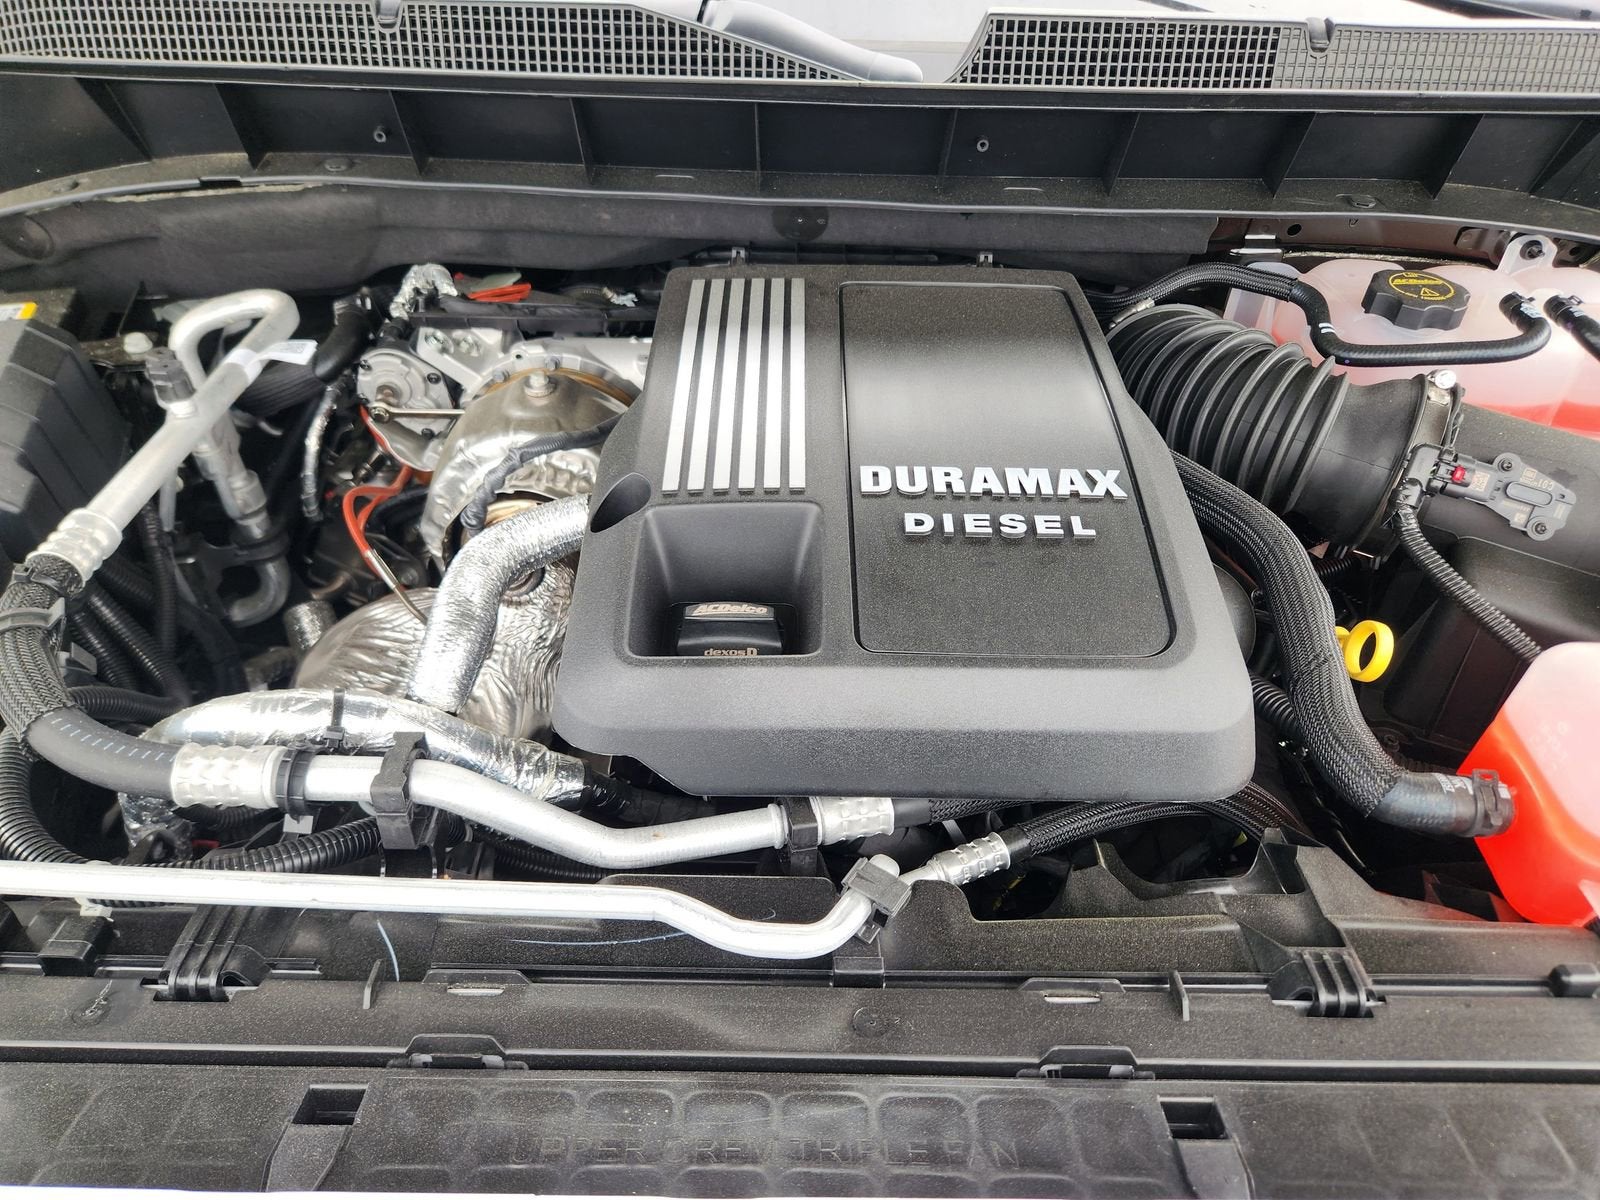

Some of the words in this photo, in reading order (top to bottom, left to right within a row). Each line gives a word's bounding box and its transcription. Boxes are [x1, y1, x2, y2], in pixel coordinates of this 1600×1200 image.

[859, 465, 1128, 500] DURAMAX
[904, 512, 1097, 539] DIESEL
[691, 604, 768, 616] ACDelco
